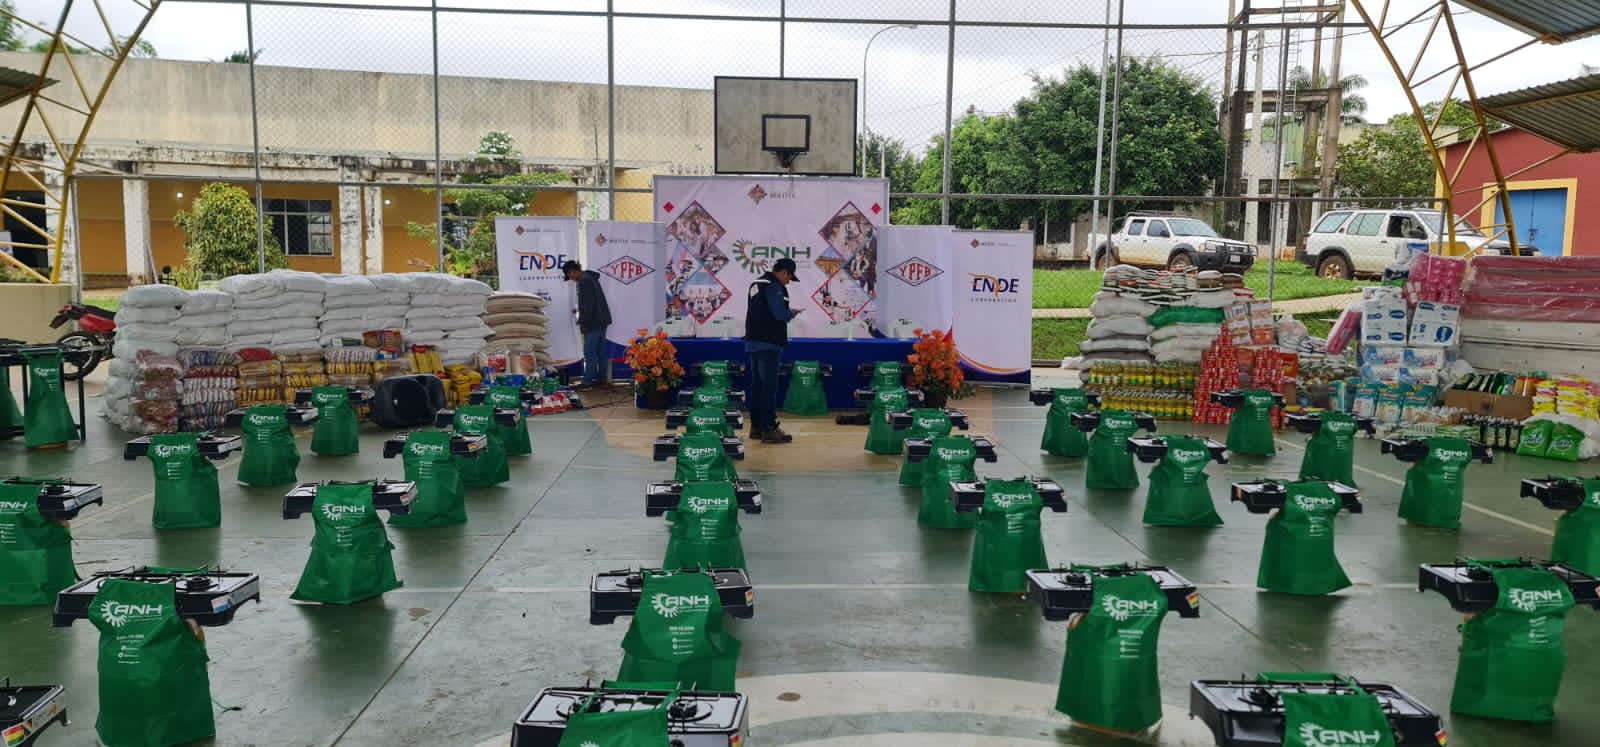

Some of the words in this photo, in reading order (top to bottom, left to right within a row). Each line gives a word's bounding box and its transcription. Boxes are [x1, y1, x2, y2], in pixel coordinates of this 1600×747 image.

[751, 246, 811, 259] ANH
[519, 254, 568, 271] ENDE
[611, 259, 643, 280] YPFB
[898, 262, 932, 281] YPFB
[972, 277, 1020, 293] ENDE
[697, 497, 729, 505] ANH
[331, 505, 366, 513] ANH
[665, 594, 709, 607] ANH
[1521, 590, 1562, 601] ANH
[114, 604, 163, 615] ANH
[1115, 599, 1158, 610] ANH
[1319, 729, 1380, 746] ANH
